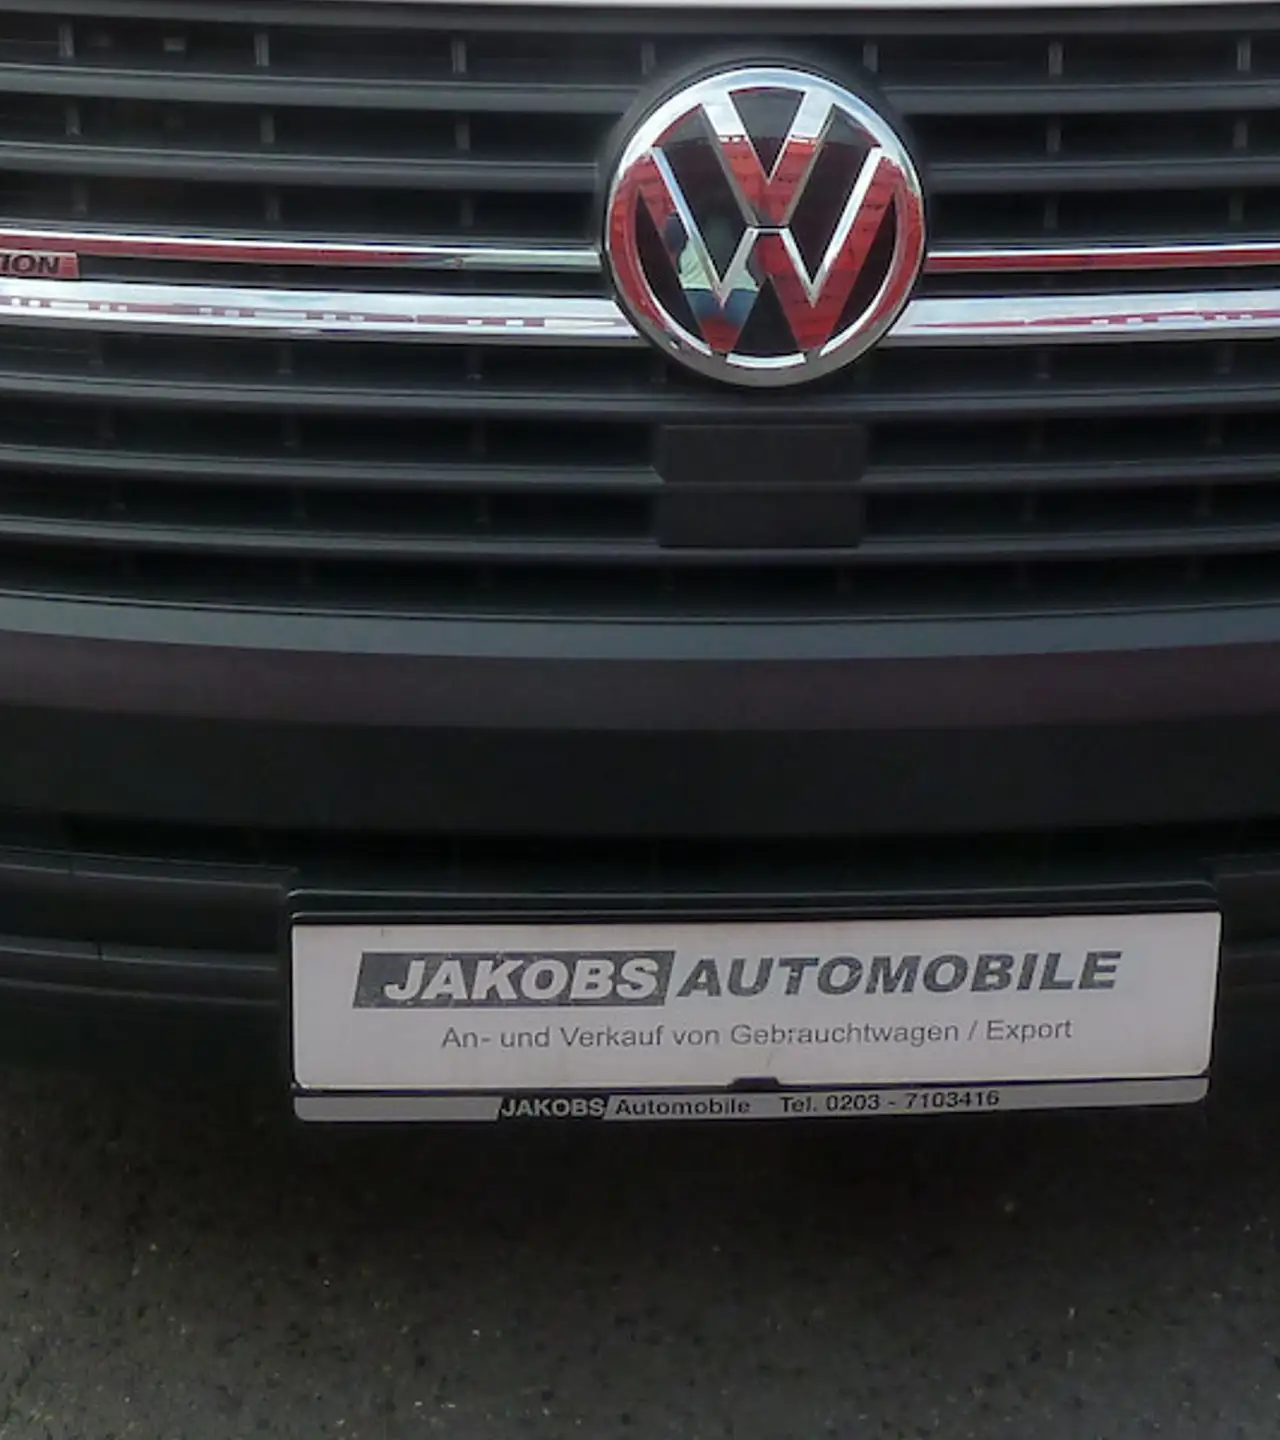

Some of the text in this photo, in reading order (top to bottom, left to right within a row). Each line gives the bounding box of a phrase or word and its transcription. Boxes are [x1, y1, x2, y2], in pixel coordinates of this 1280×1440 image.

[383, 950, 1123, 1001] JAKOBS AUTOMOBILE
[441, 1026, 492, 1049] An-
[500, 1026, 550, 1048] und
[560, 1024, 665, 1049] Verkauf
[671, 1027, 720, 1047] von
[731, 1021, 959, 1048] Gebrauchtwagen
[986, 1017, 1073, 1043] Export
[500, 1097, 606, 1118] JAKOBS
[614, 1097, 751, 1117] Automobile
[781, 1096, 817, 1113] Tel.
[825, 1094, 880, 1111] 0203
[905, 1089, 1000, 1110] 7103416
